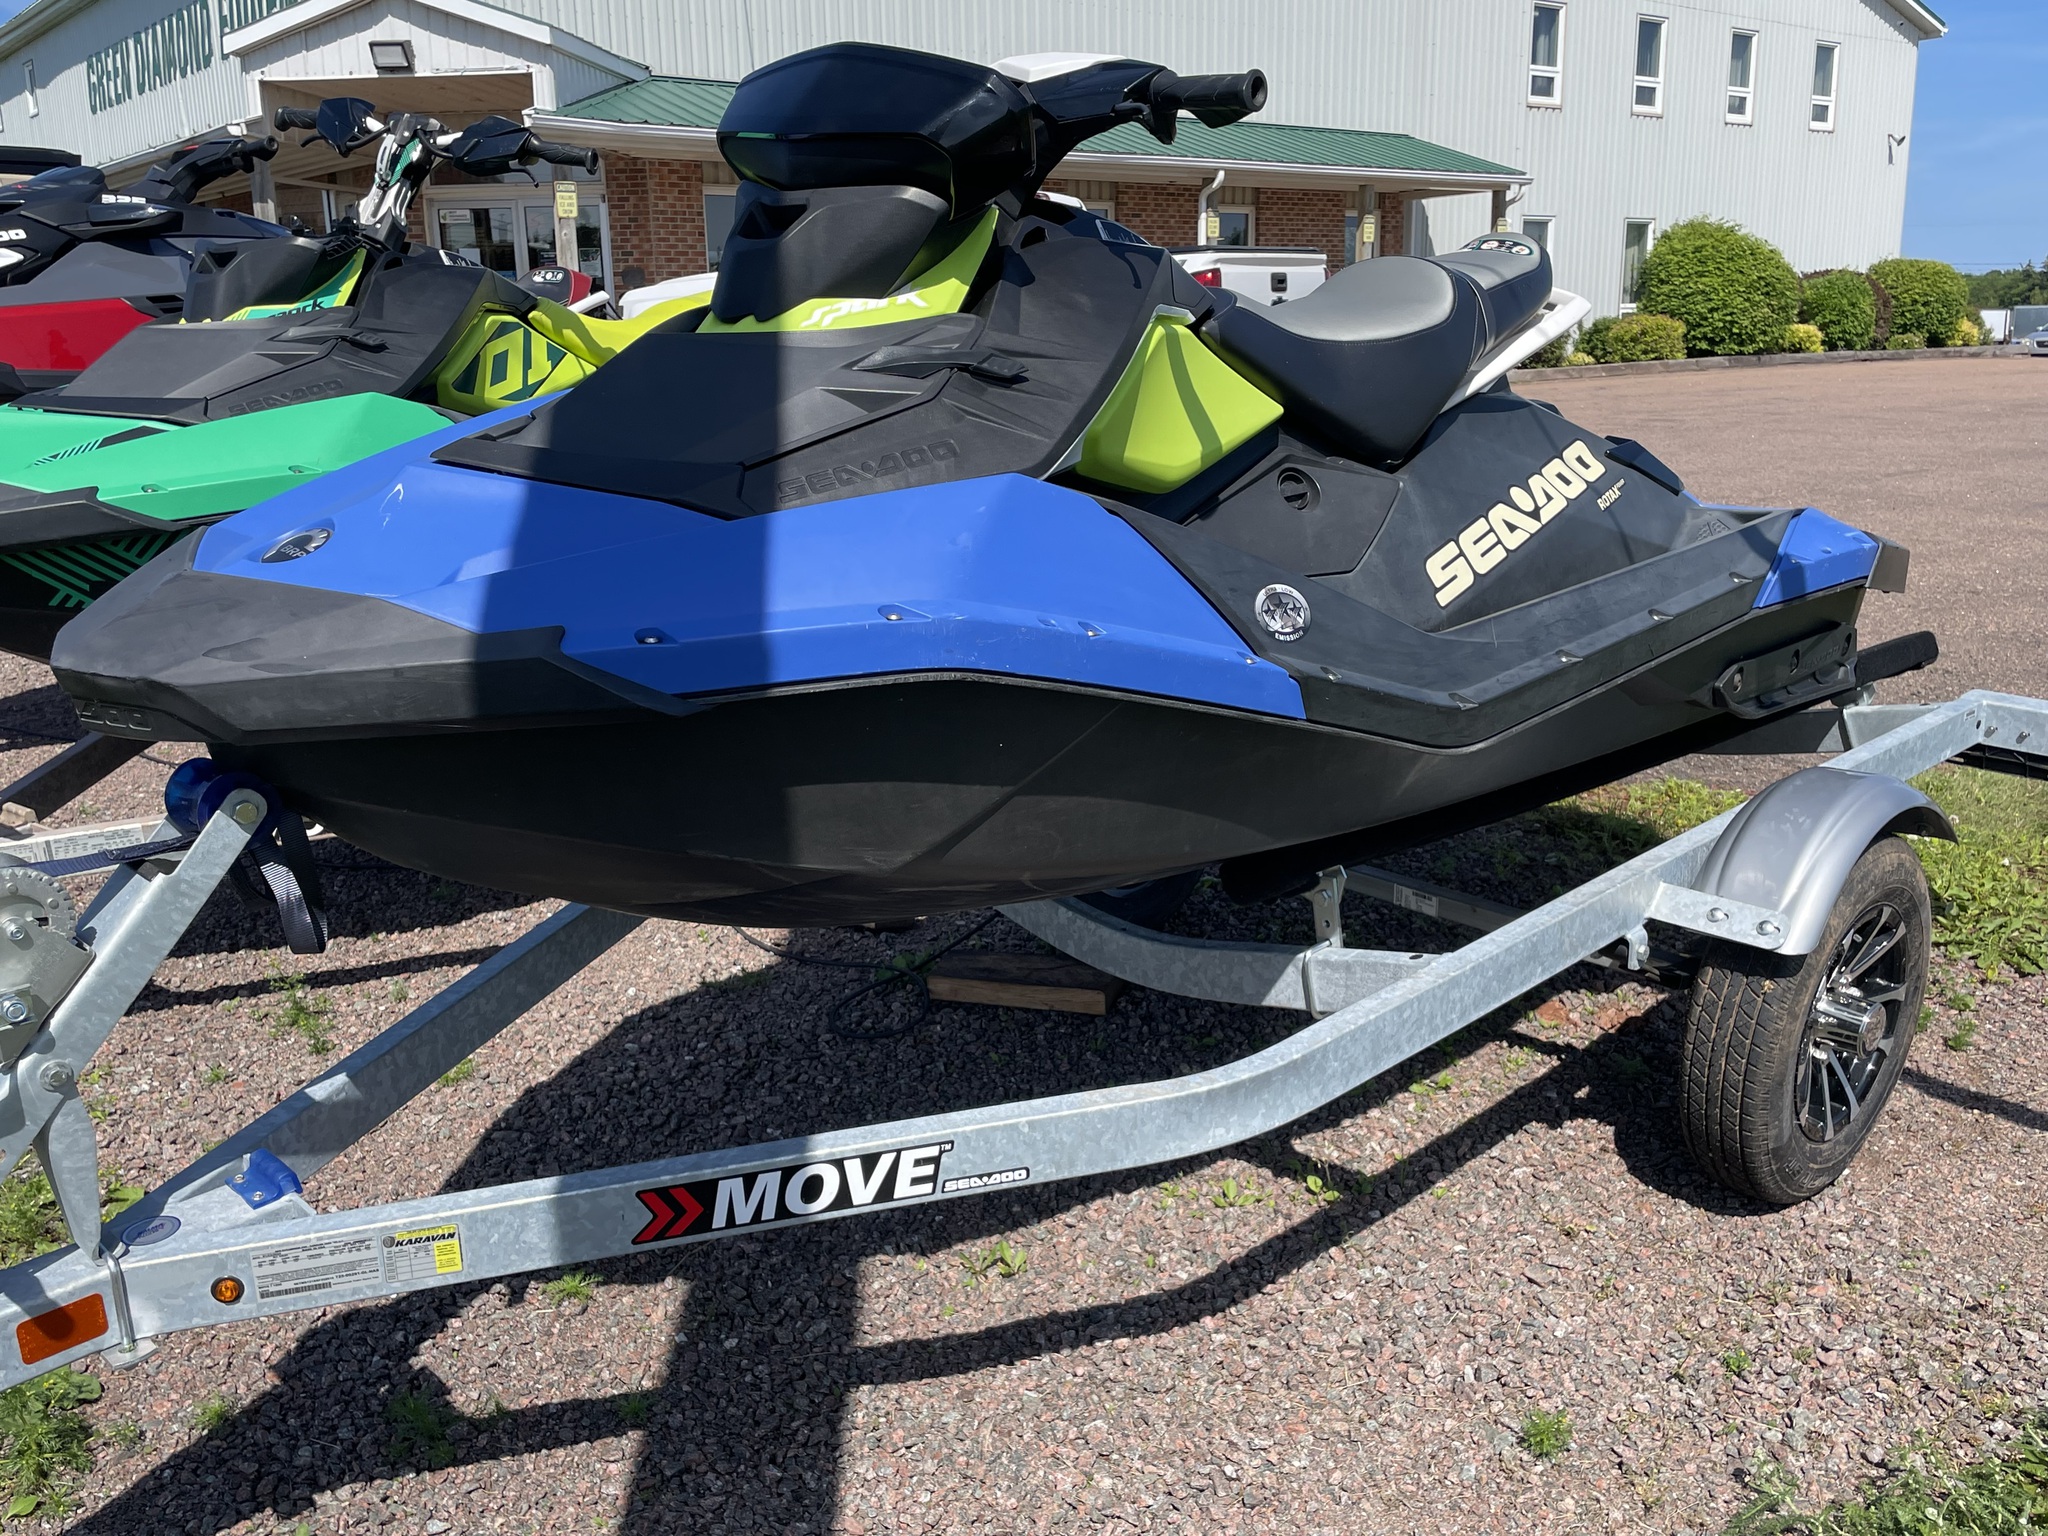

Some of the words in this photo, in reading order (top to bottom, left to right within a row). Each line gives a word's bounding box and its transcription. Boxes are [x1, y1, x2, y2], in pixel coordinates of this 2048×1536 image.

[86, 36, 133, 115] GREEN
[133, 0, 213, 96] DIAMOND
[1596, 484, 1622, 511] ROTAX
[280, 544, 307, 558] BRP
[711, 1144, 941, 1229] MOVE
[394, 1231, 457, 1248] KARAVAN
